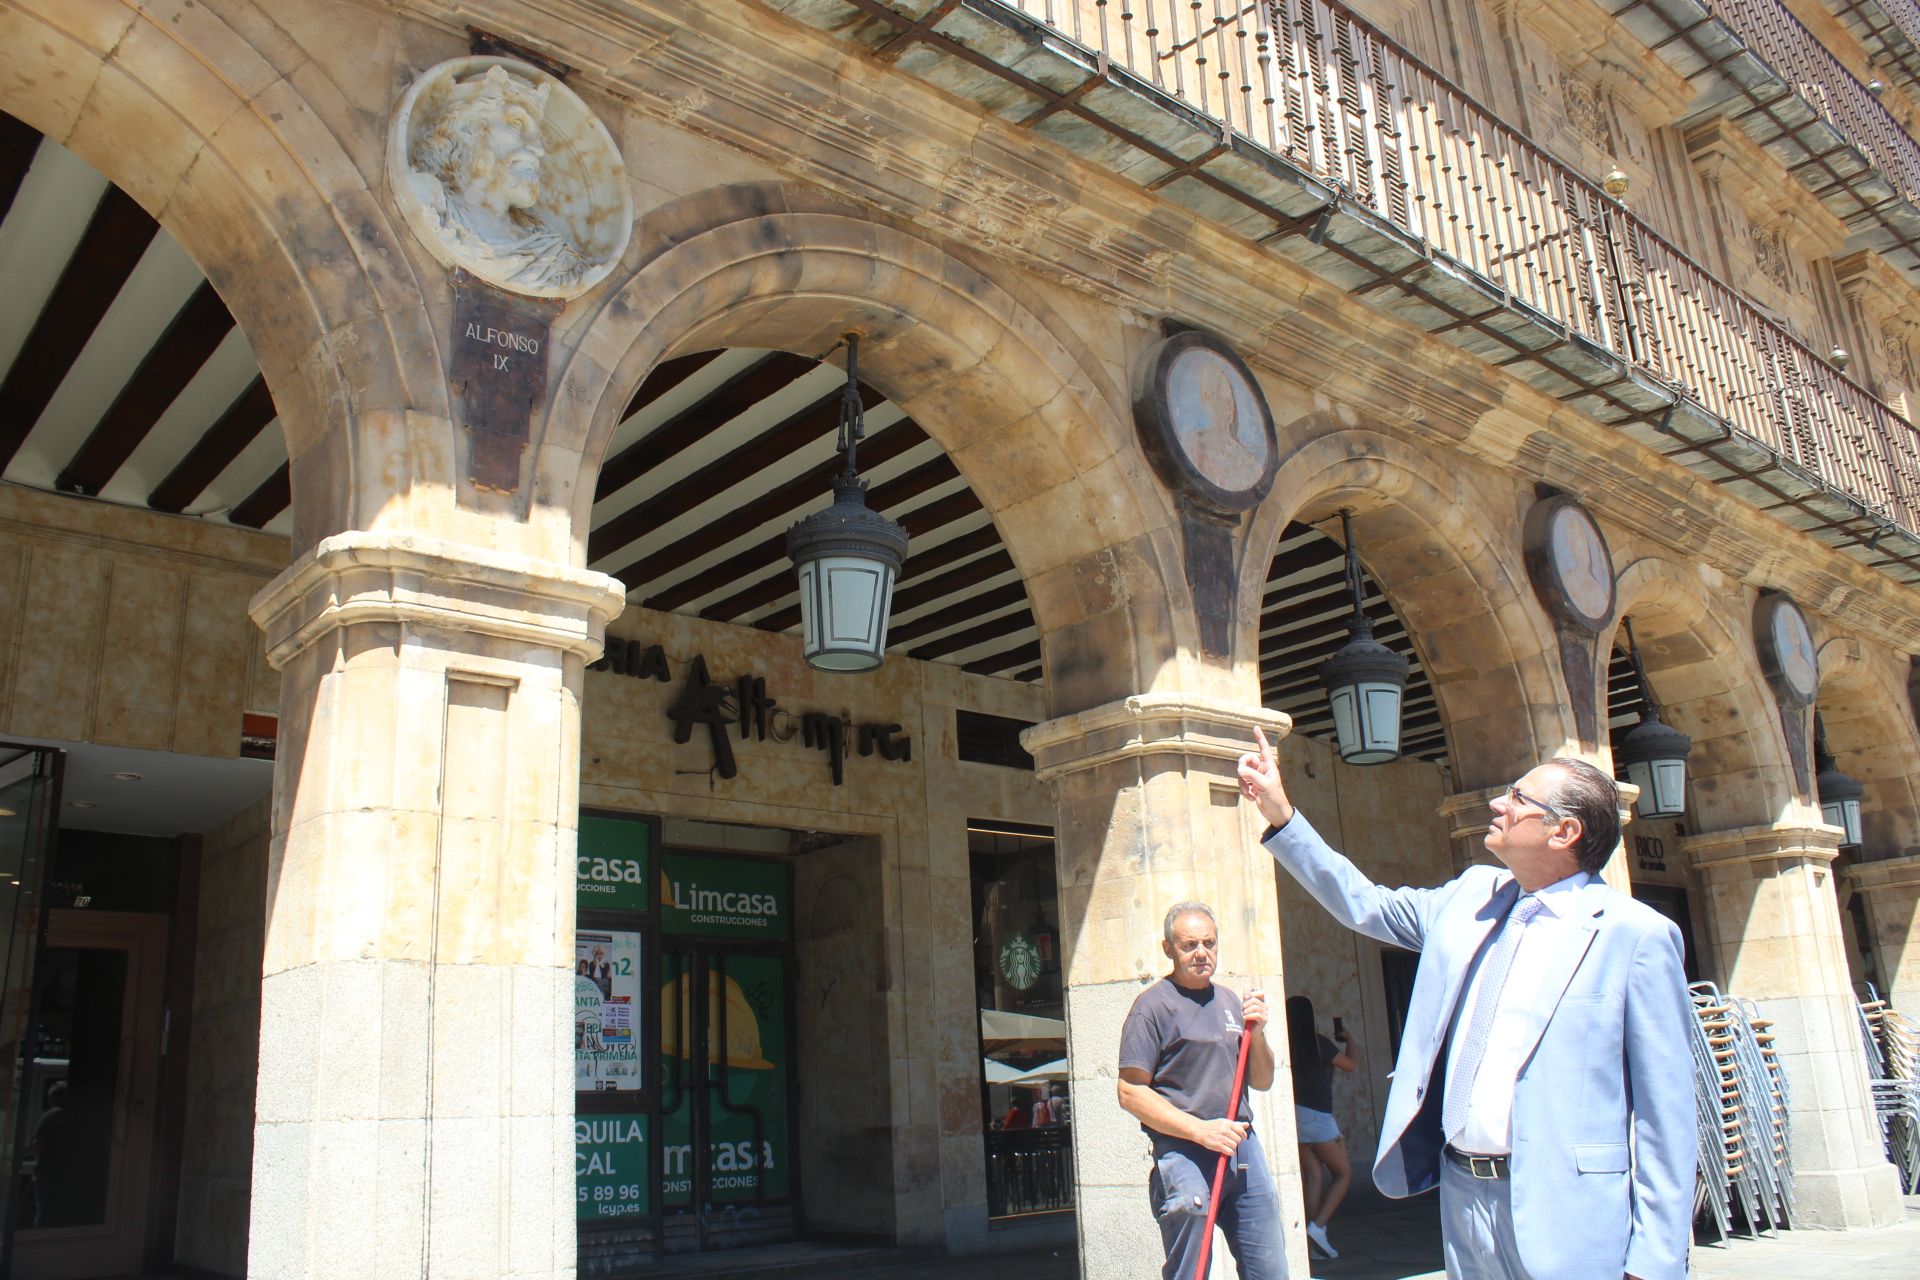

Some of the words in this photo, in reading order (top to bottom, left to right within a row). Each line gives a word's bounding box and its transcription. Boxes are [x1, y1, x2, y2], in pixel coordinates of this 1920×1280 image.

[465, 322, 539, 355] ALFONSO
[493, 353, 510, 372] IX
[673, 881, 778, 916] Limcasa
[690, 913, 768, 927] CONSTRUCCIONES
[593, 1185, 614, 1201] 89
[618, 1184, 640, 1200] 96
[598, 1203, 640, 1216] lcyp.es
